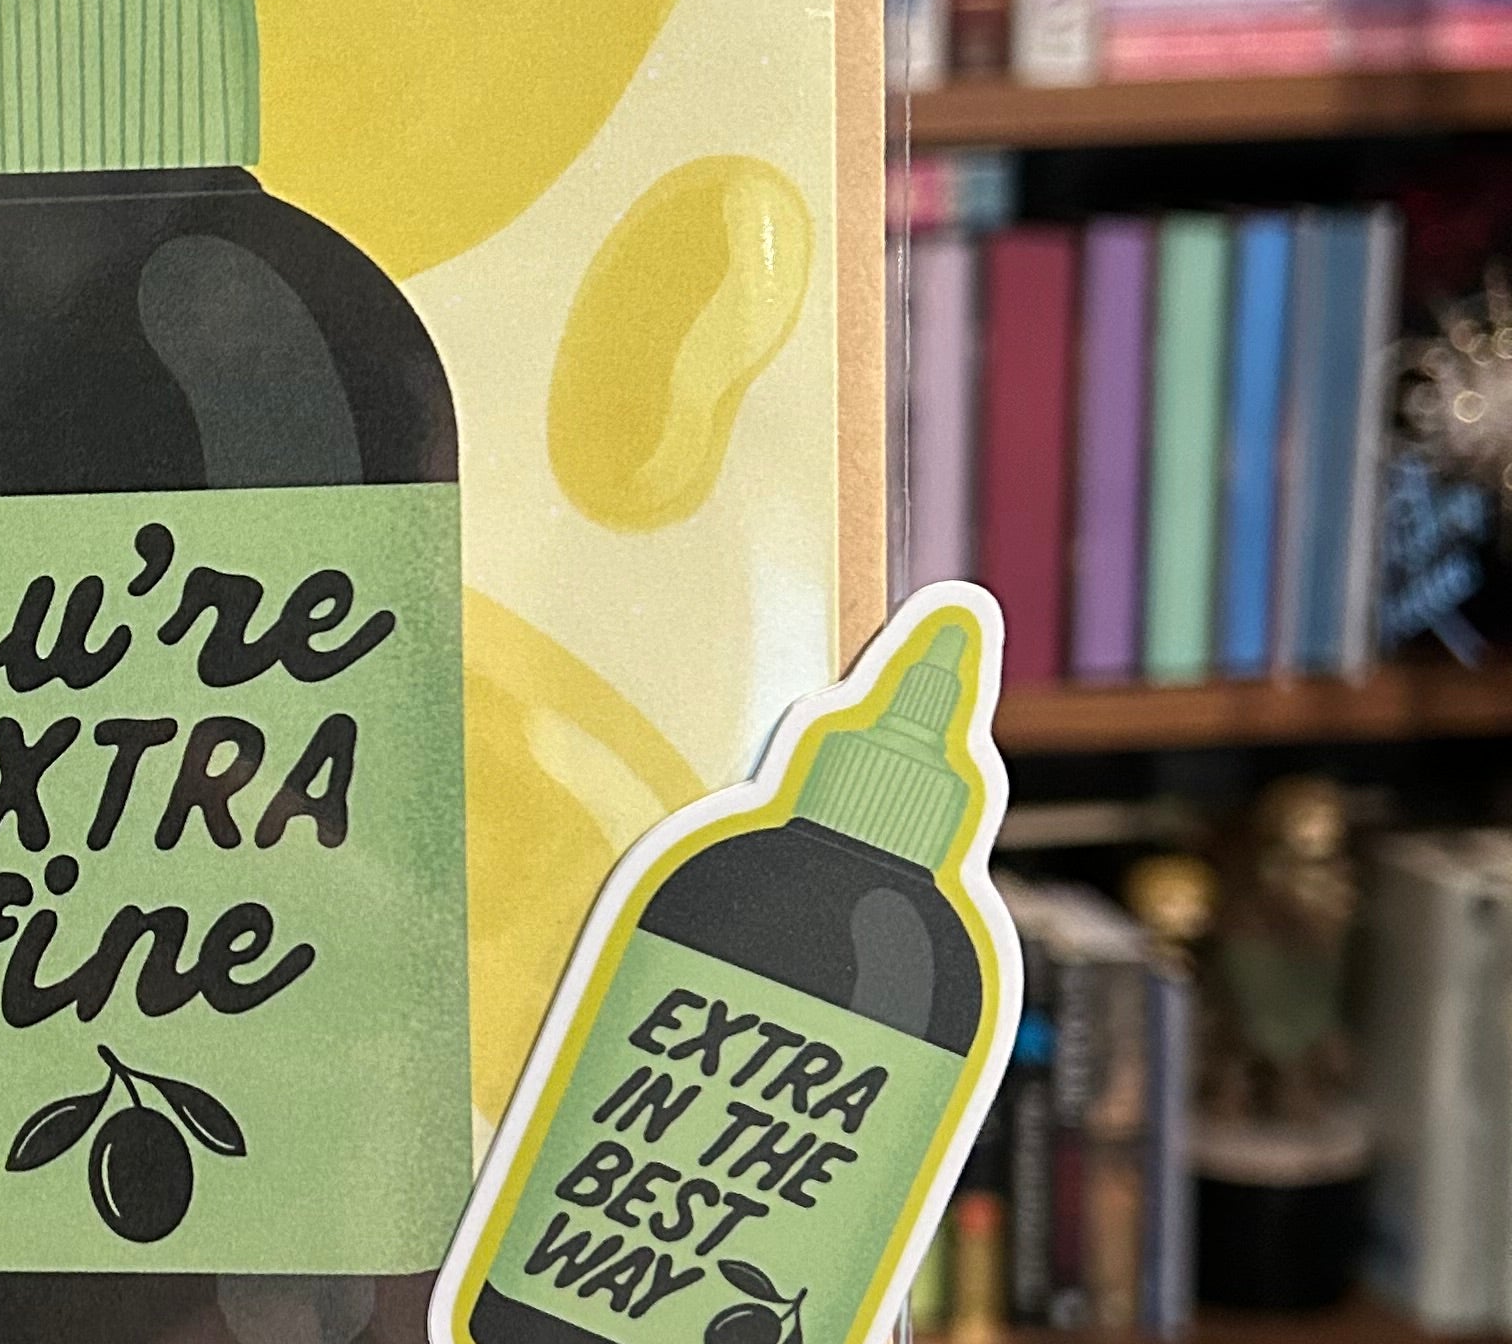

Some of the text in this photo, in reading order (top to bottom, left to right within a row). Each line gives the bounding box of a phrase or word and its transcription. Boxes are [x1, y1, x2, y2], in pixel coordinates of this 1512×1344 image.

[628, 987, 889, 1134] EXTRA
[554, 1140, 770, 1257] BEST
[592, 1065, 859, 1209] IN THE
[523, 1211, 706, 1320] WAY
